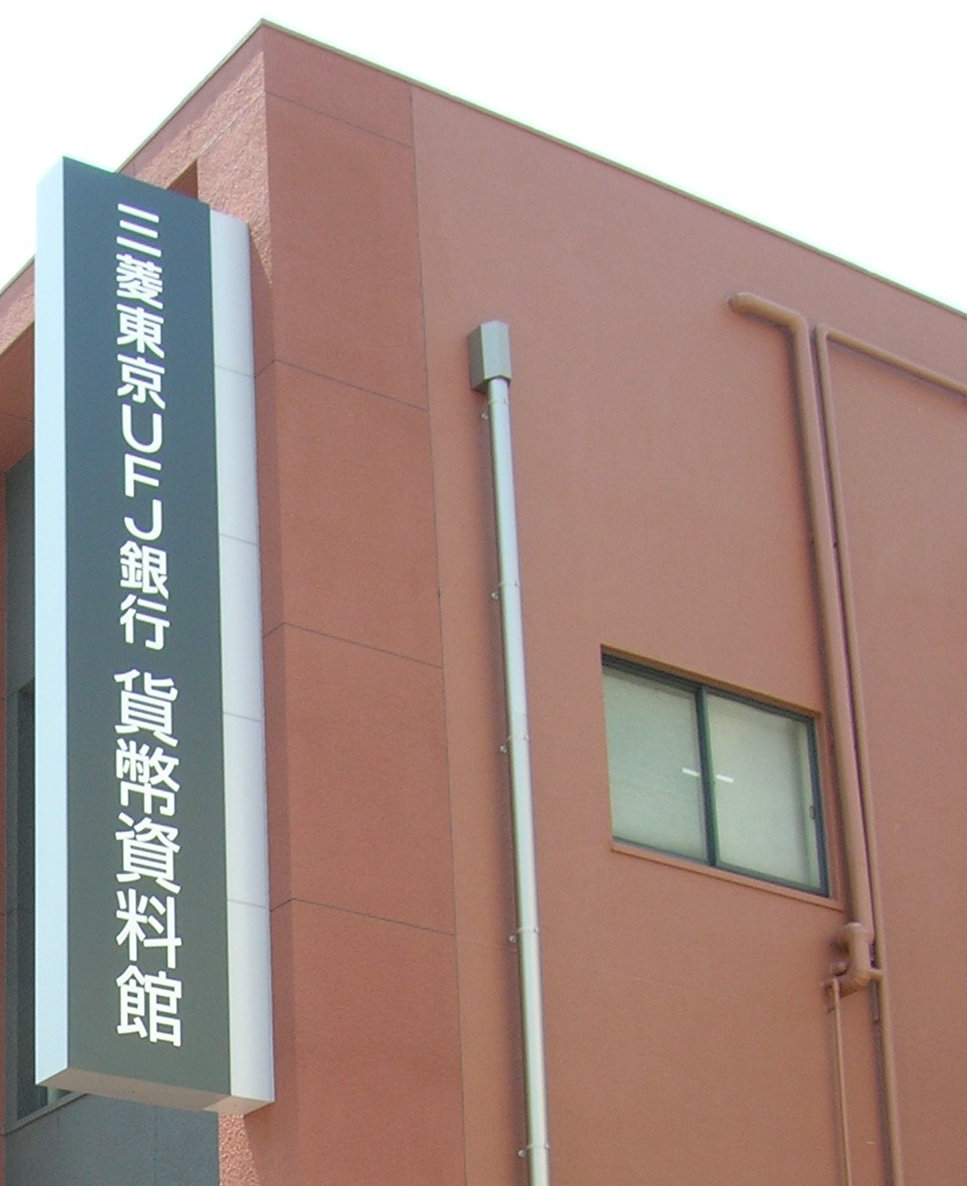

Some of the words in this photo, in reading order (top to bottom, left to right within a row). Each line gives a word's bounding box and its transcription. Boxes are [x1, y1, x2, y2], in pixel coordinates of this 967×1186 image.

[116, 202, 170, 651] 三菱東京UFJ銀行
[114, 669, 182, 1047] 貨幣資料館
